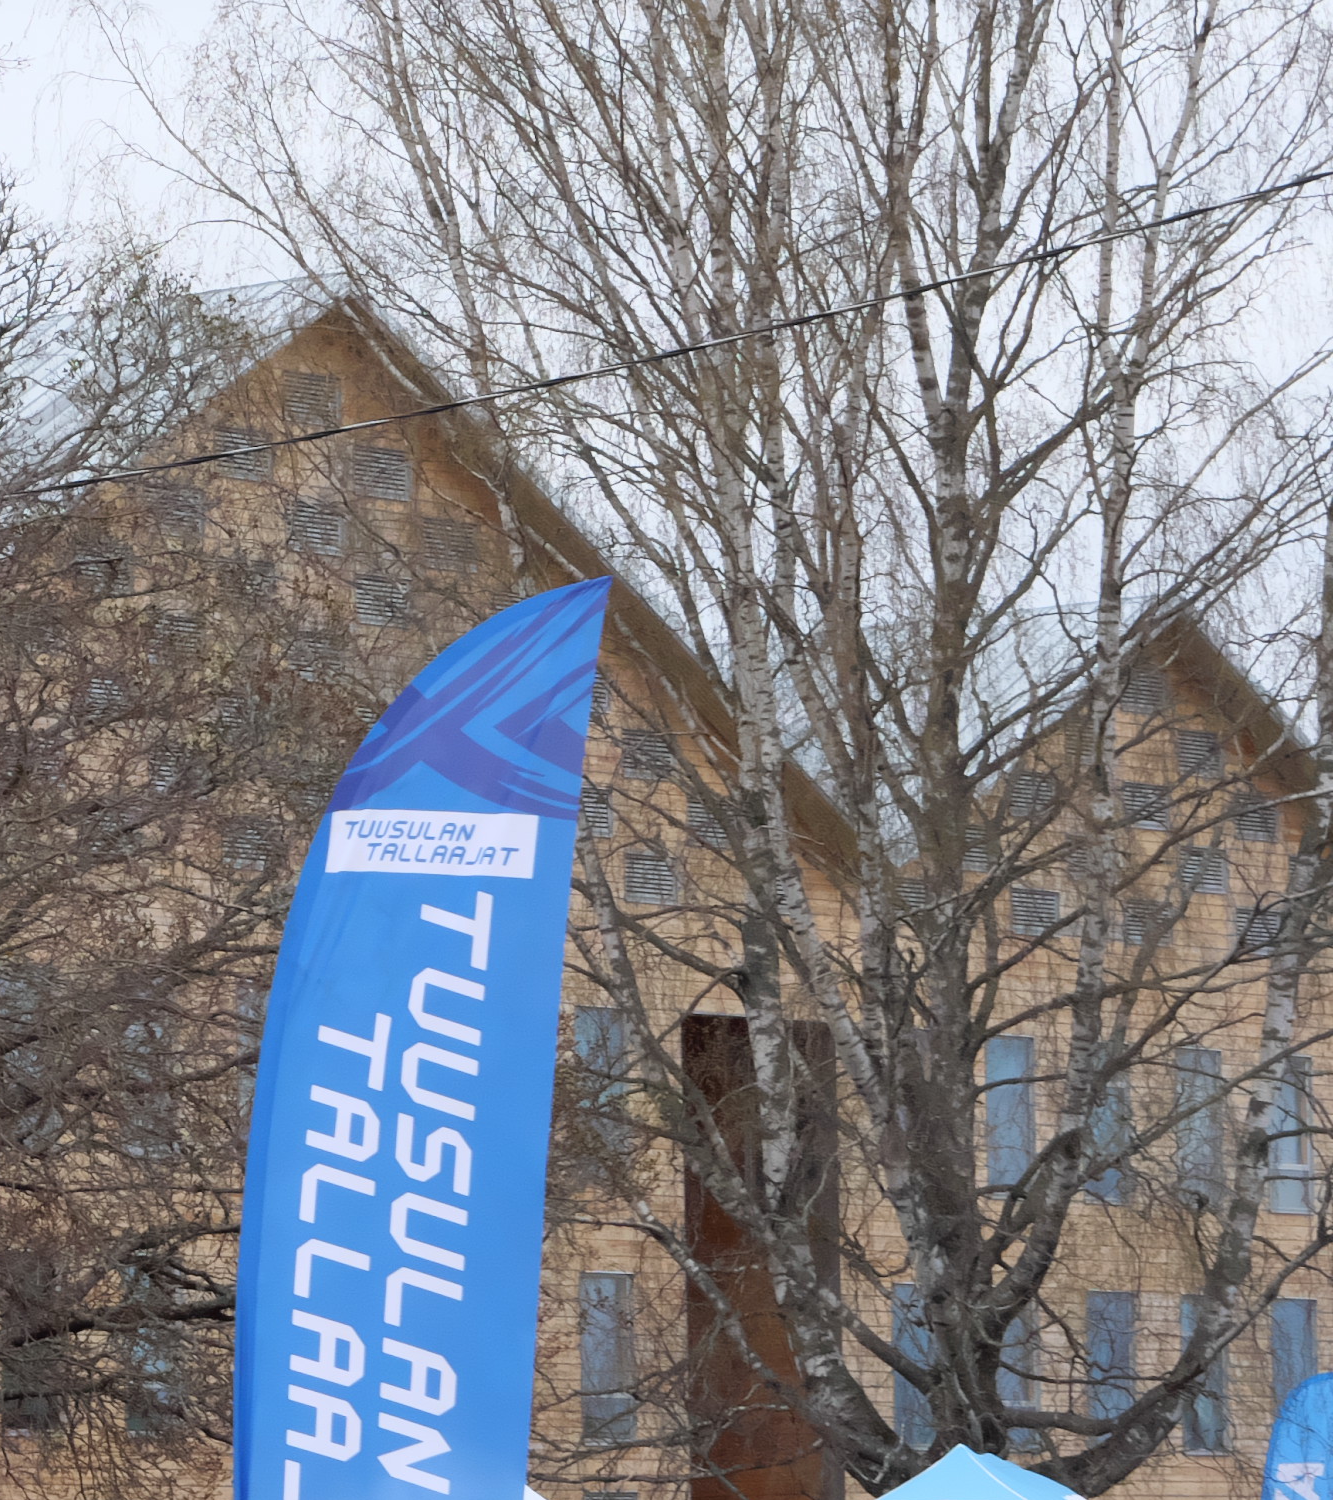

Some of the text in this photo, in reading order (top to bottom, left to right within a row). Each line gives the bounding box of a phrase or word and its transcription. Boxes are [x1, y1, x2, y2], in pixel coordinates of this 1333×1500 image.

[344, 819, 477, 842] TUUSULAN
[366, 842, 519, 867] TALLAAJAT
[377, 891, 493, 1495] TUUSULAN
